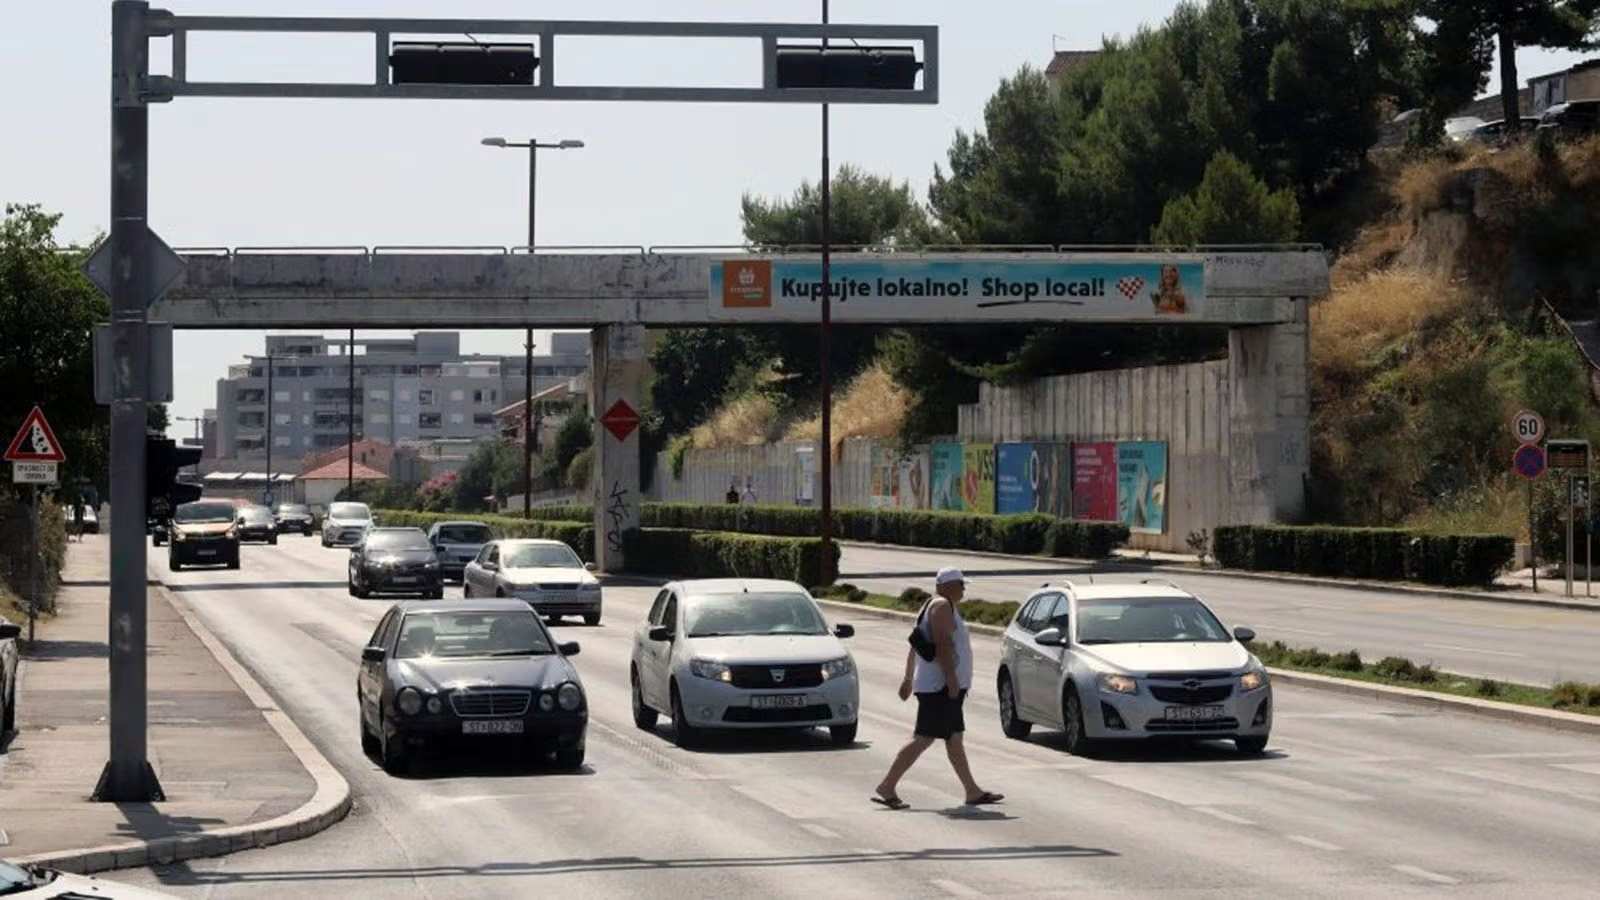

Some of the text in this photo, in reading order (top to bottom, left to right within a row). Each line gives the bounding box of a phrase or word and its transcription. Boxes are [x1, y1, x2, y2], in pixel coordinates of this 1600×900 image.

[781, 277, 872, 302] Kupujte
[877, 276, 969, 297] lokalno!
[981, 277, 1039, 302] Shop
[1046, 277, 1105, 297] local!
[1519, 419, 1537, 435] 60
